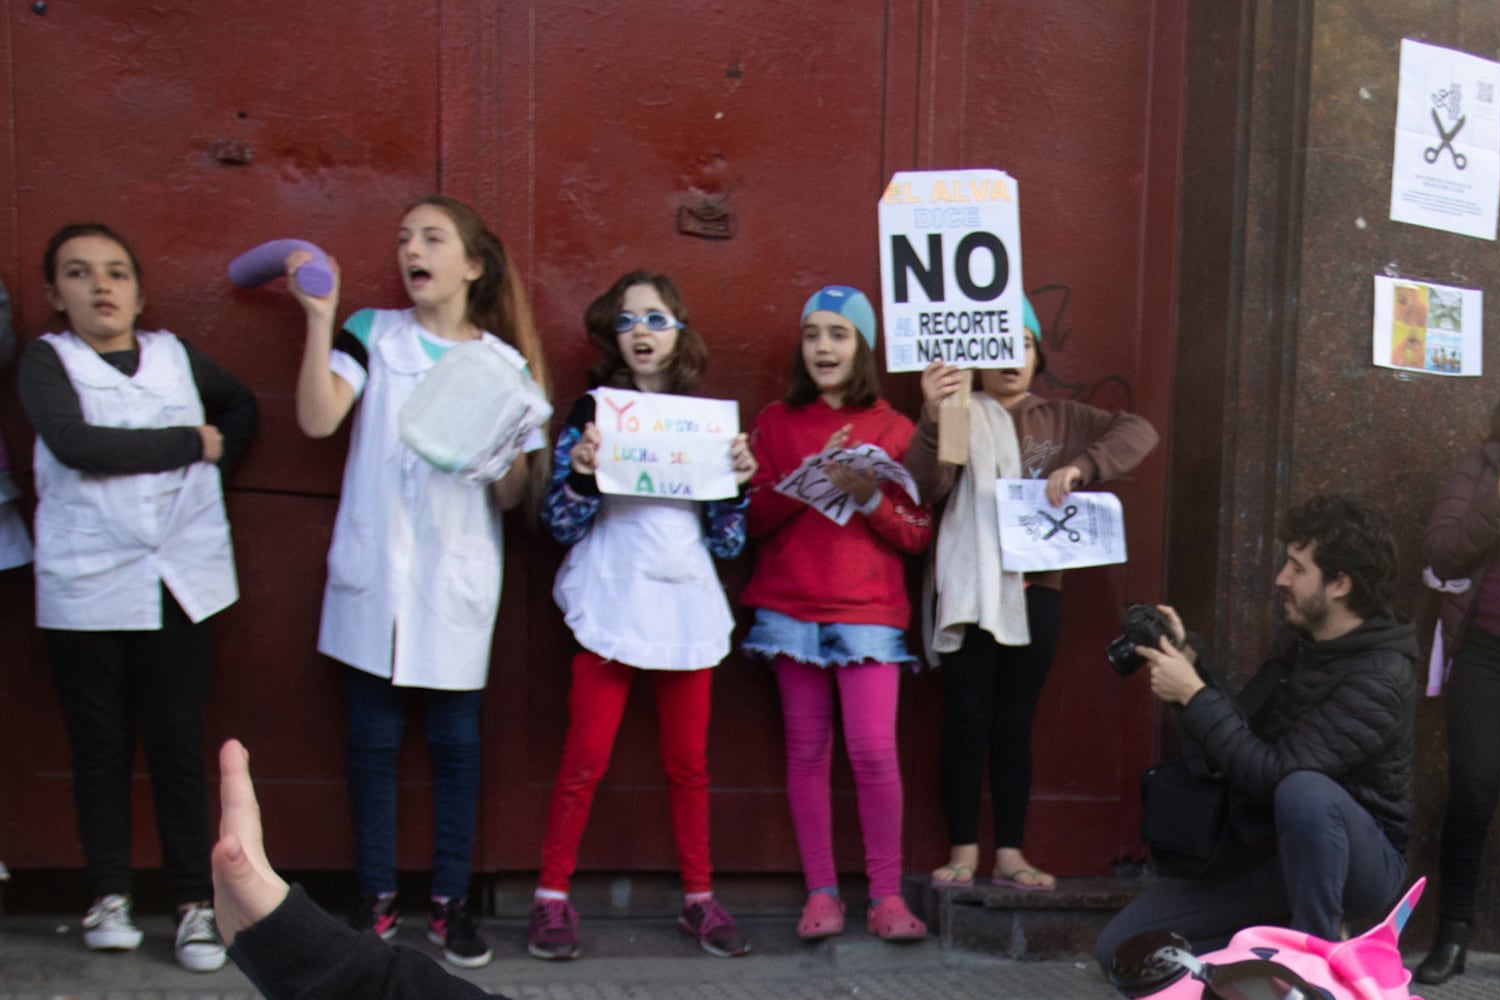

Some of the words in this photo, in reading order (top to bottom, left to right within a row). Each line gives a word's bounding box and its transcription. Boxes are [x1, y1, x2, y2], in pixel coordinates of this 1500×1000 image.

[883, 183, 920, 204] EL
[931, 180, 1012, 203] ALVA
[914, 207, 981, 229] DICE
[890, 231, 1010, 303] NO
[918, 310, 1009, 335] RECORTE
[917, 336, 1014, 363] NATACION
